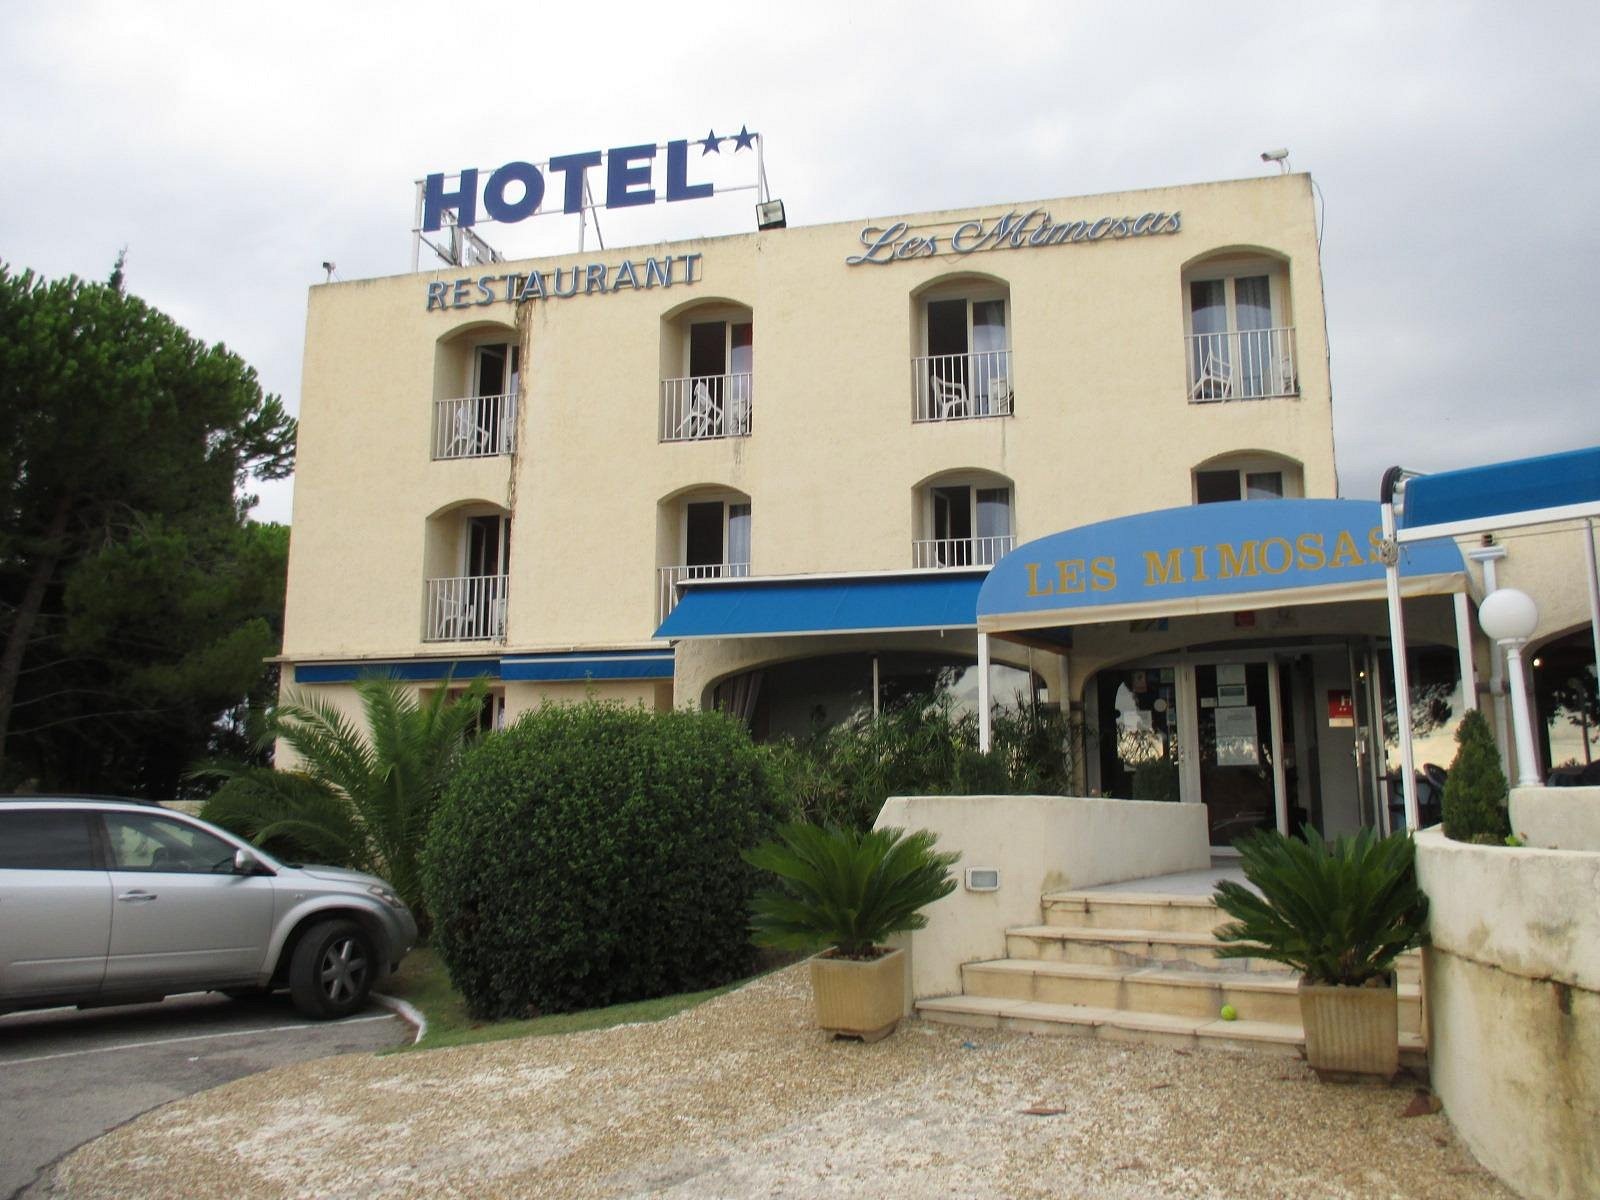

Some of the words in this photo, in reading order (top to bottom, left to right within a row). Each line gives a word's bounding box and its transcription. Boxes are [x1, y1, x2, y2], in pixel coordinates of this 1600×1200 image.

[423, 139, 714, 232] HOTEL
[846, 221, 937, 266] Les
[951, 207, 1183, 255] Mimosas
[426, 252, 704, 312] RESTAURANT
[1025, 555, 1118, 598] LES
